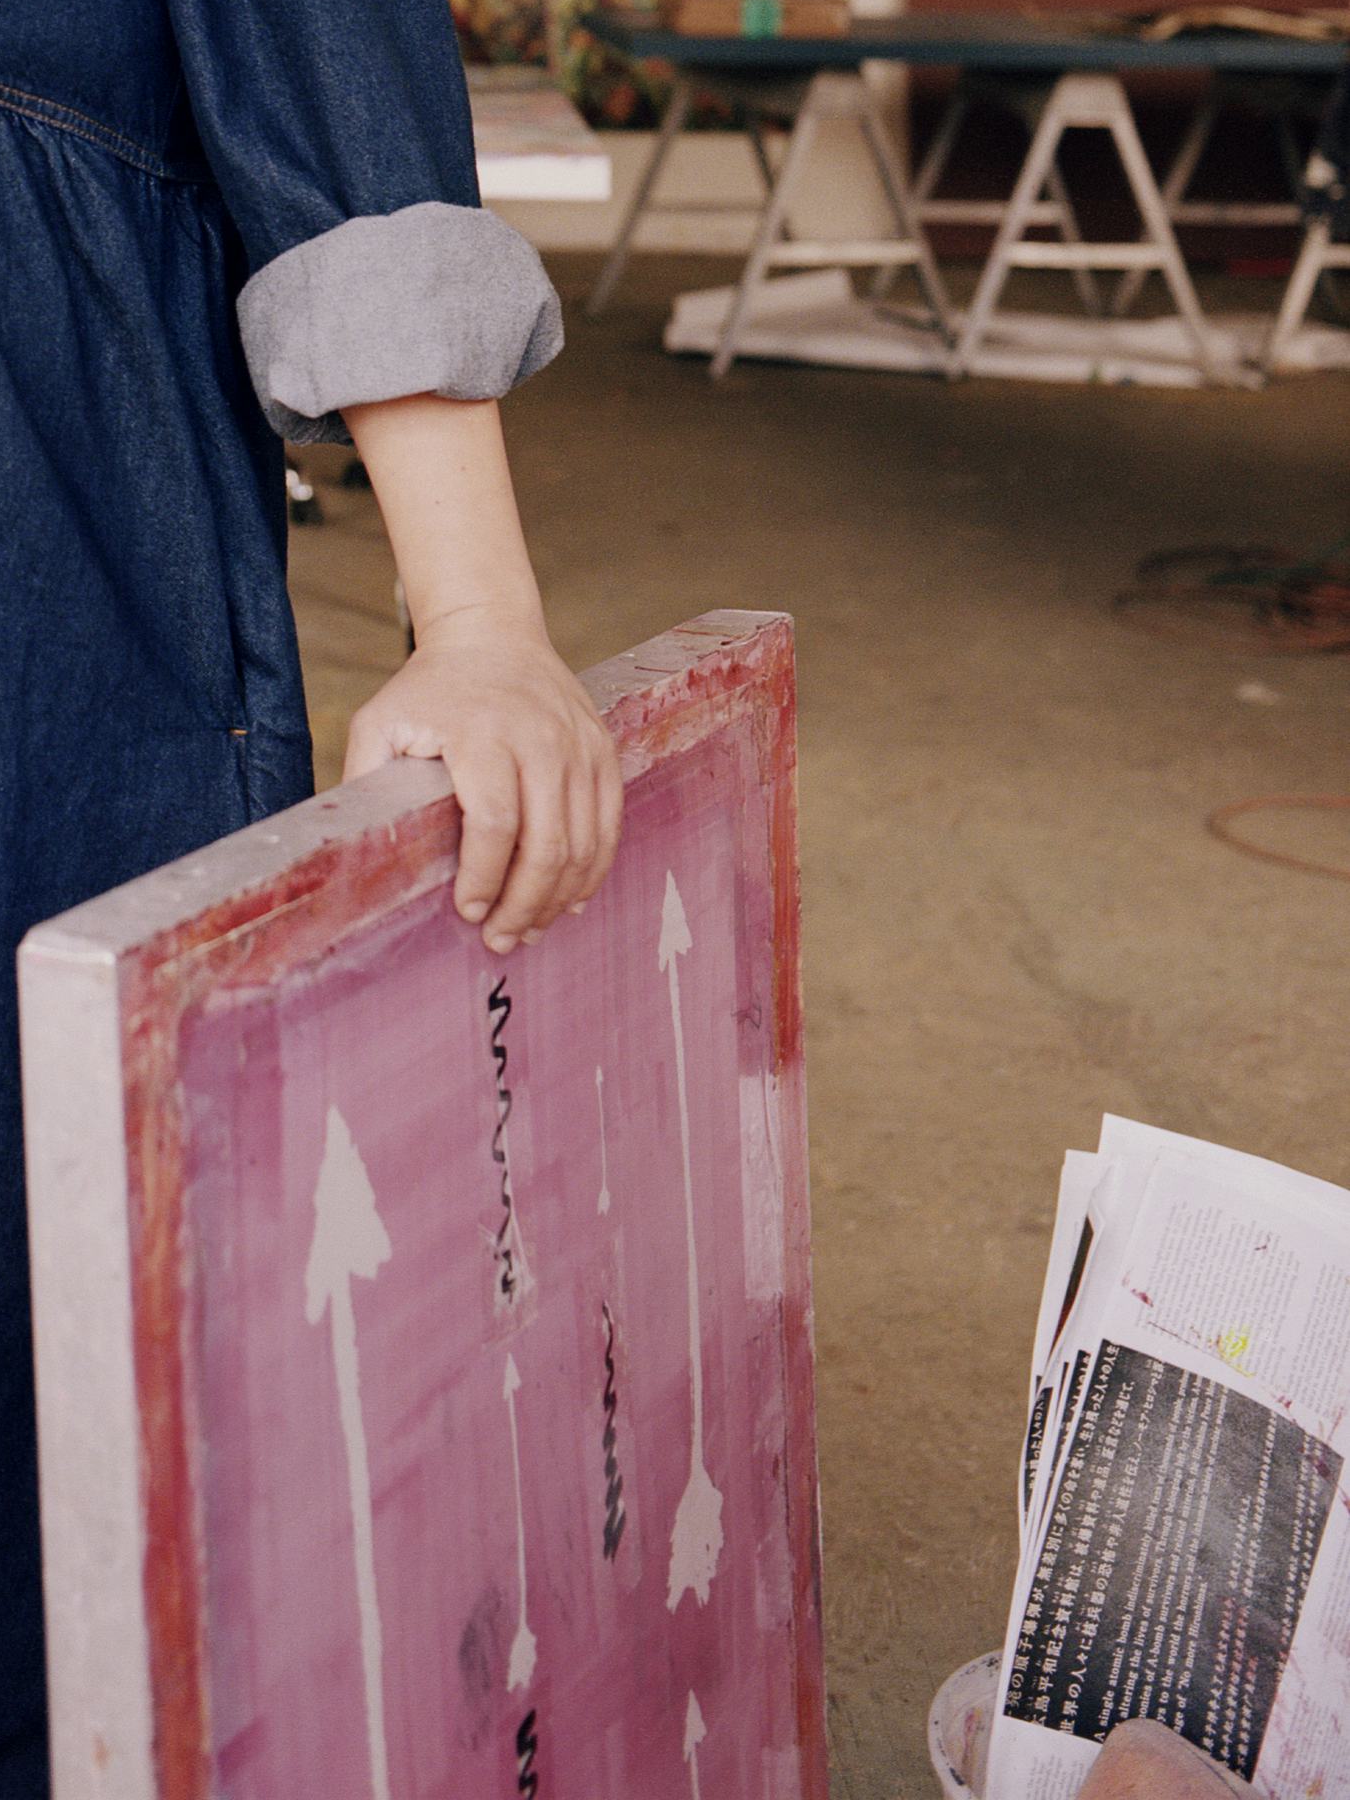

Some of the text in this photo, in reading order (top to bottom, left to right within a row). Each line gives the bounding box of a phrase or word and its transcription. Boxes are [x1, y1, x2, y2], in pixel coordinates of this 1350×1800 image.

[1005, 1344, 1119, 1715] 発の原子爆弾が、無差別に多くの命を奪い、生き残った人々の人生
[1143, 1504, 1157, 1531] killed
[1154, 1513, 1173, 1553] Through
[1173, 1518, 1187, 1552] related
[1188, 1536, 1199, 1552] the
[1123, 1531, 1153, 1611] indiscriminately
[1169, 1553, 1179, 1571] and
[1185, 1553, 1195, 1572] and
[1144, 1555, 1163, 1604] survivors.
[1175, 1574, 1191, 1611] horrors
[1140, 1605, 1151, 1617] of
[1158, 1573, 1176, 1622] survivors
[1116, 1612, 1132, 1643] bomb
[1133, 1619, 1148, 1646] lives
[1172, 1613, 1184, 1631] the
[1128, 1647, 1142, 1668] the
[1146, 1623, 1164, 1667] A-bomb
[1165, 1633, 1180, 1665] world
[1107, 1645, 1124, 1687] atomic
[1145, 1669, 1155, 1682] of
[1160, 1668, 1173, 1687] the
[1175, 1693, 1186, 1708] of
[1185, 1640, 1196, 1668] more
[1096, 1688, 1115, 1727] single
[1117, 1669, 1138, 1719] altering
[1159, 1690, 1169, 1703] to
[1093, 1729, 1105, 1741] A
